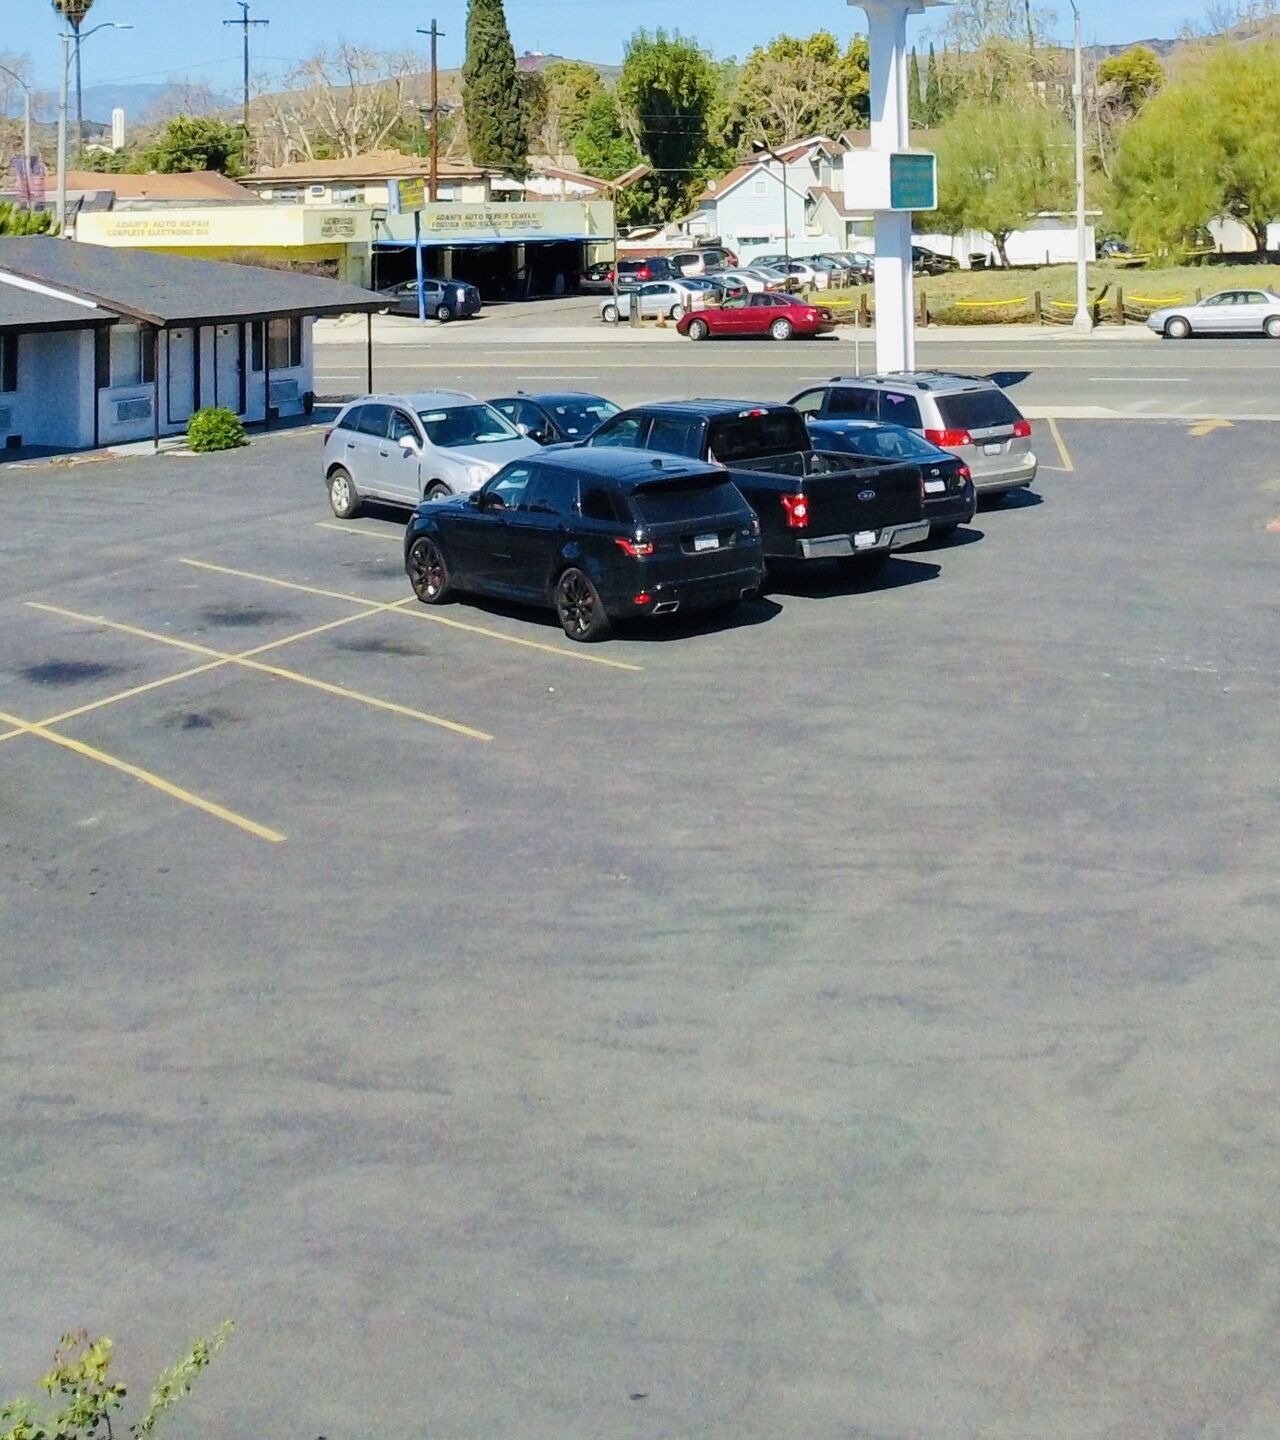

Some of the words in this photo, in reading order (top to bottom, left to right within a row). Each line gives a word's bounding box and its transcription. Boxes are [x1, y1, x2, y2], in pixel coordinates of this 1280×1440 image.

[464, 213, 484, 221] AUTO
[152, 220, 177, 228] AUTO
[107, 229, 145, 237] COMPLETE
[148, 228, 194, 236] ELECTRONIC
